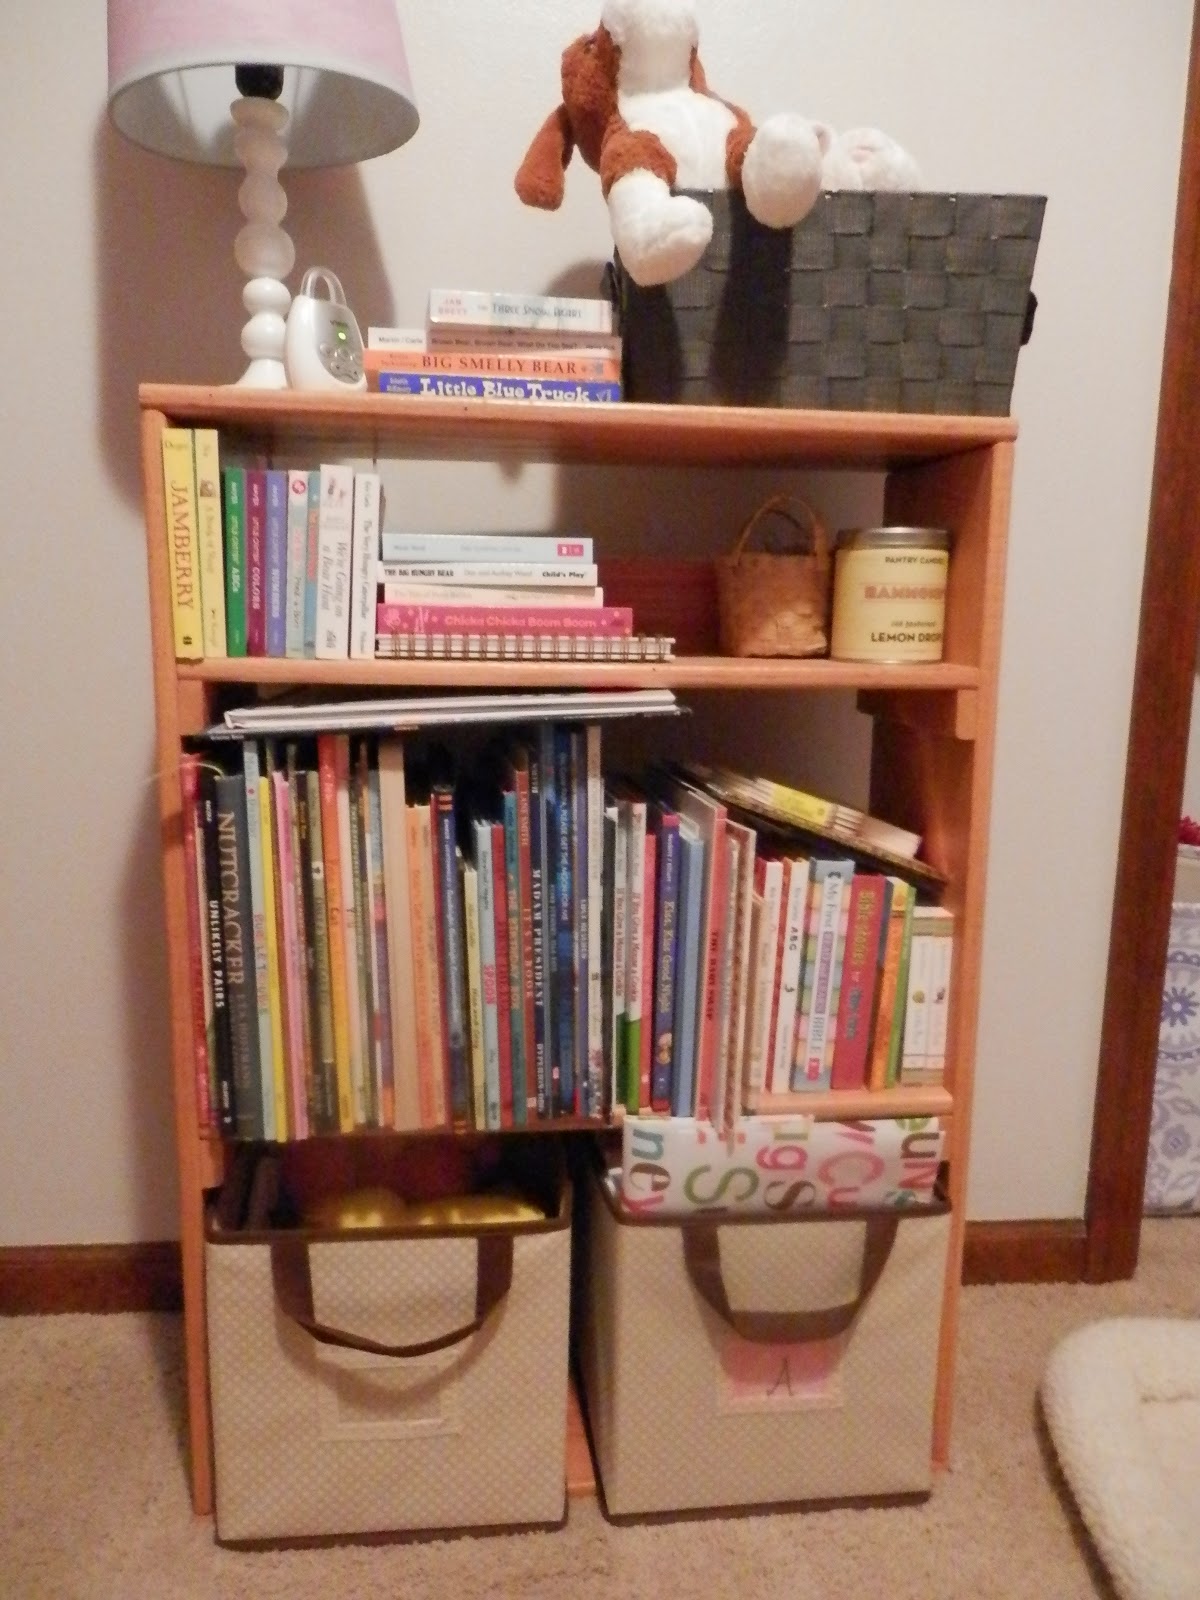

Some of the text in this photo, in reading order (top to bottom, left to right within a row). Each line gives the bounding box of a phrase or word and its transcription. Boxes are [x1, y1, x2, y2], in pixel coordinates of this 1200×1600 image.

[421, 354, 452, 370] BIG
[458, 357, 525, 373] SMELLY
[531, 359, 577, 375] BEAR
[419, 376, 479, 397] Little
[481, 379, 526, 400] Blue
[526, 382, 591, 404] Truck
[170, 479, 195, 610] JAMBERRY
[541, 570, 566, 579] Child's
[568, 571, 585, 580] Play
[527, 616, 561, 628] Boom
[562, 617, 598, 629] Boom
[870, 631, 916, 643] LEMON
[216, 810, 246, 985] NUTCRACKER
[531, 868, 542, 922] MADAM
[827, 882, 841, 901] My
[824, 903, 839, 929] First
[788, 926, 800, 953] ABC
[208, 899, 225, 1009] UNLIKELY PAIRS
[533, 926, 544, 1007] PRESIDENT
[524, 959, 535, 999] BOOK
